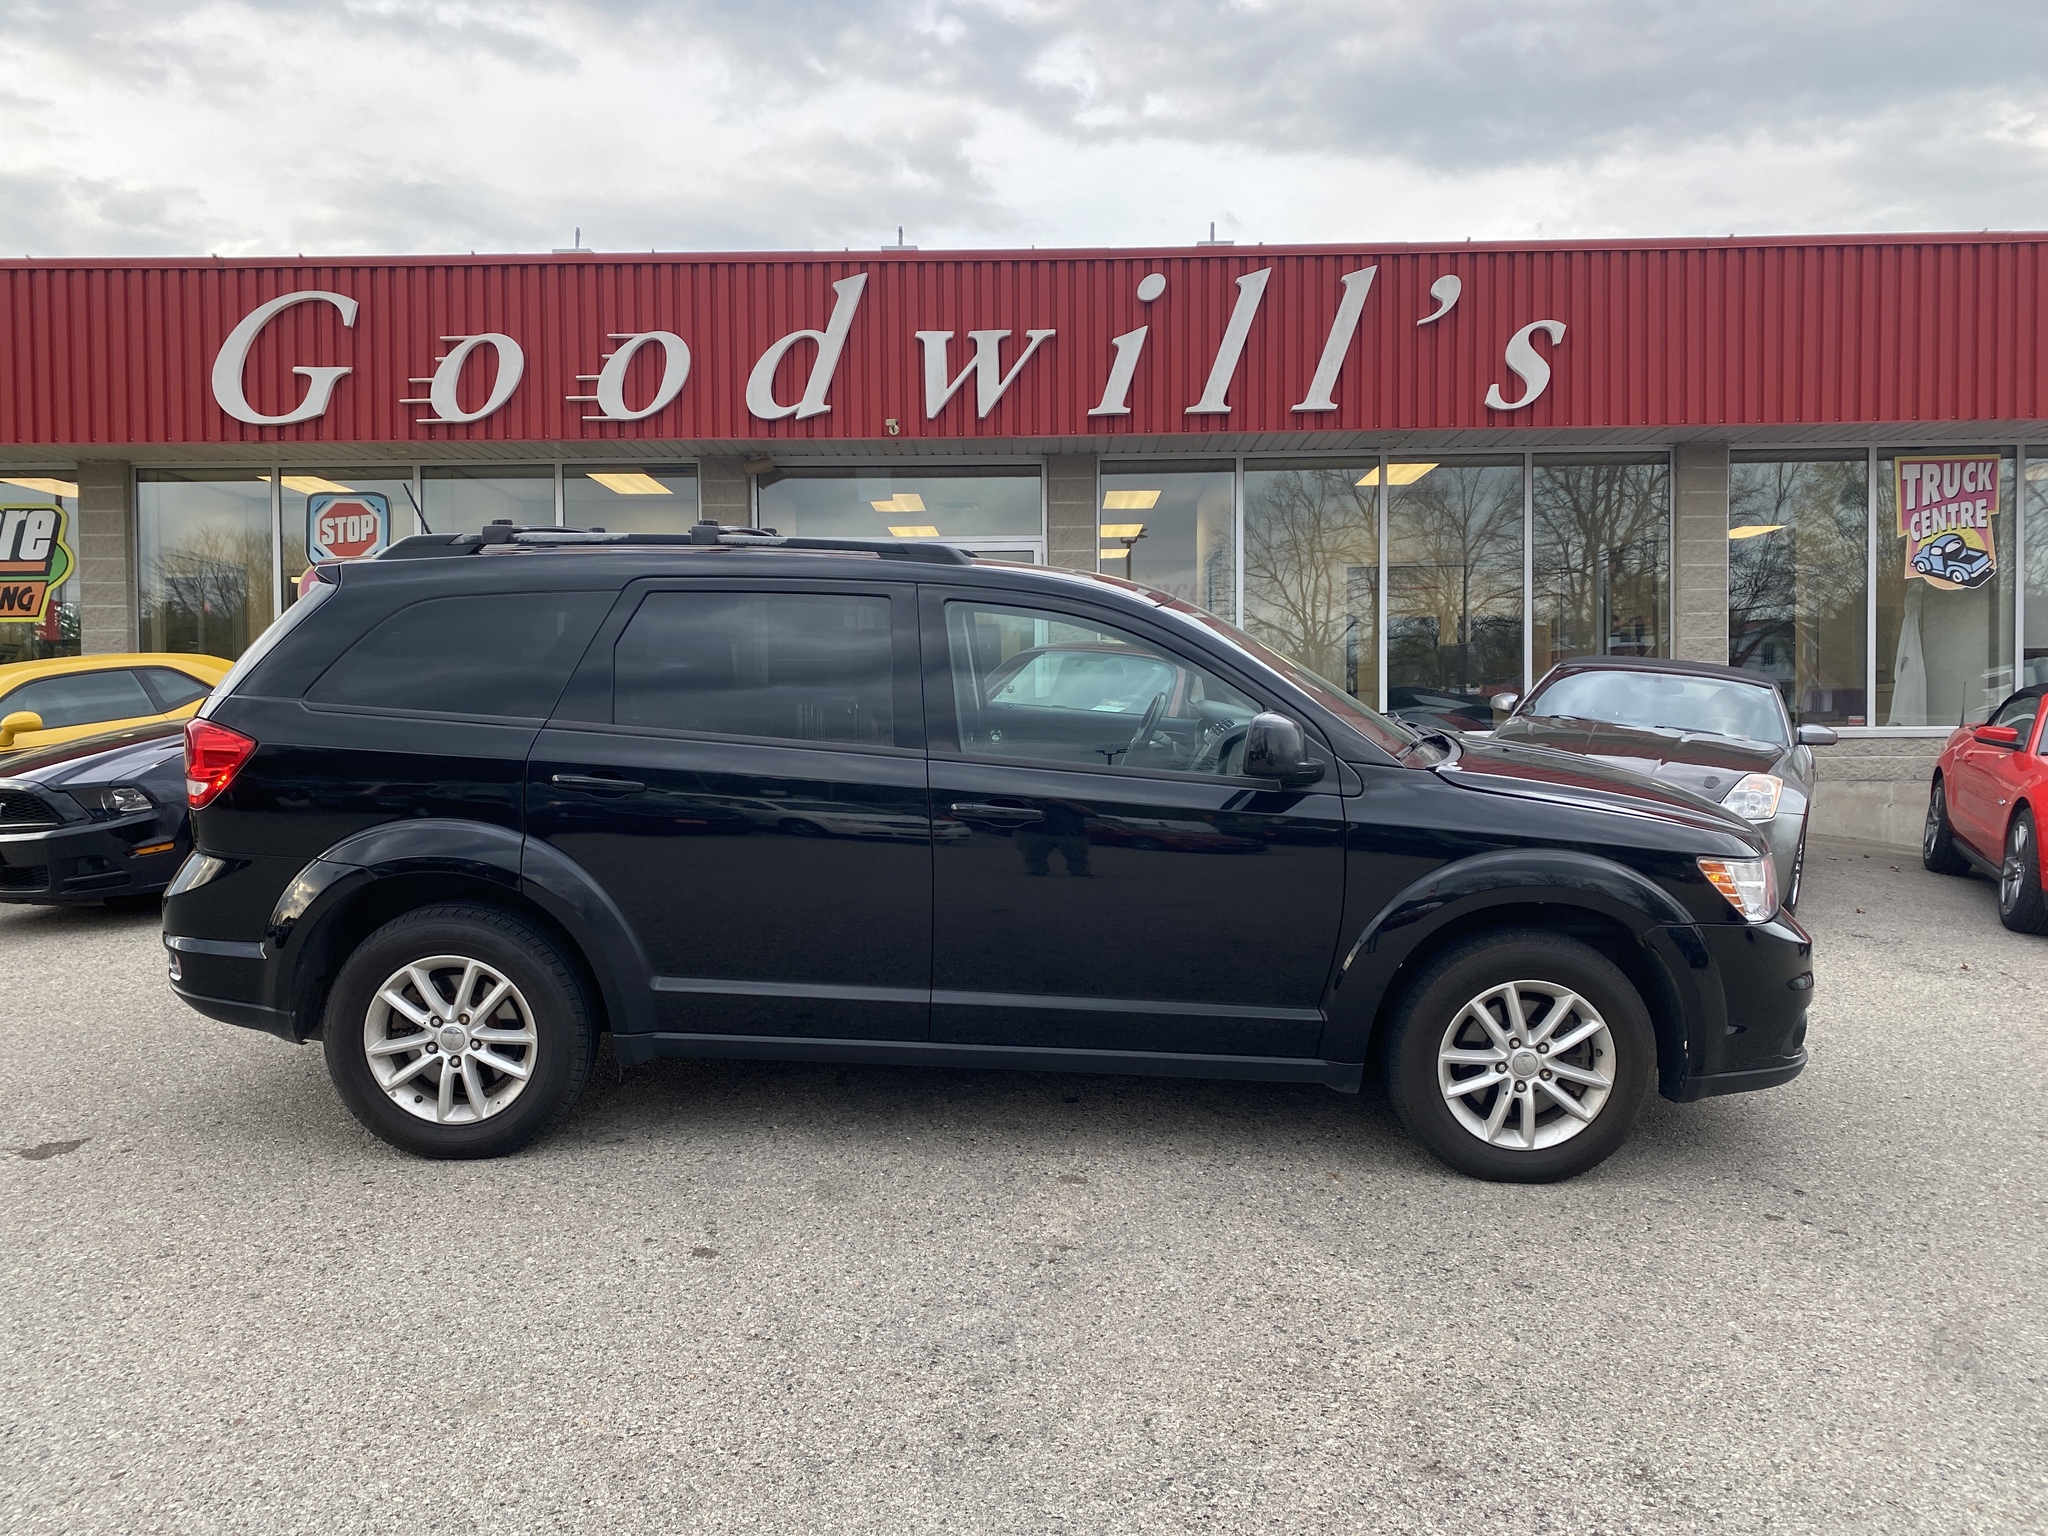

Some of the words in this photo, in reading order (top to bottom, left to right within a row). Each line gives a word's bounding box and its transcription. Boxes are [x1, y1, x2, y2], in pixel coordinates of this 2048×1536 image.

[1902, 461, 1994, 511] TRUCK
[0, 510, 56, 561] re
[321, 514, 374, 545] STOP
[1910, 498, 1988, 542] CENTRE
[0, 585, 35, 611] NG
